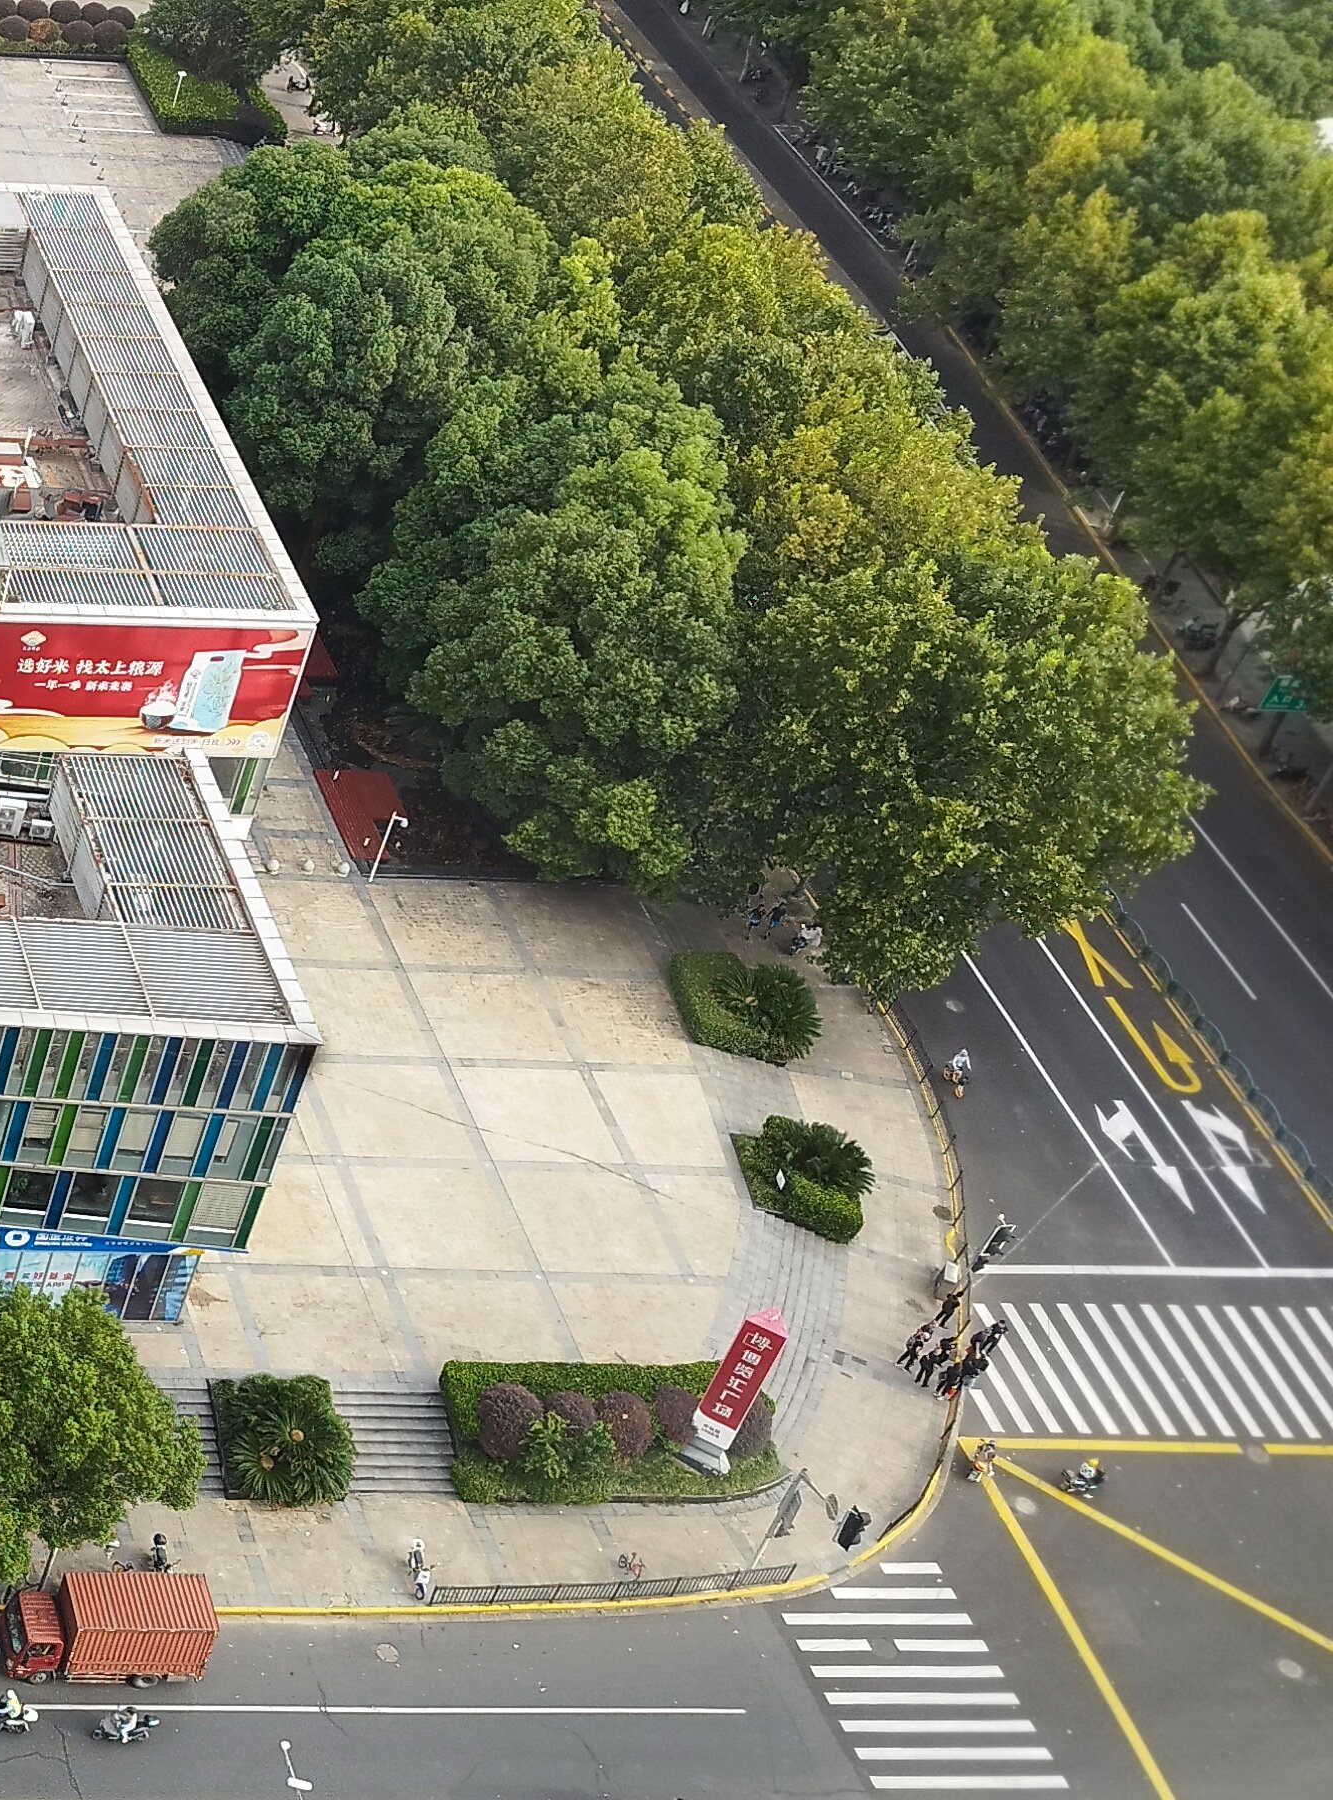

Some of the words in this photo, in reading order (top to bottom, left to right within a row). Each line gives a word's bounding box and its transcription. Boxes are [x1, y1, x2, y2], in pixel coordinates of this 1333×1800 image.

[17, 657, 70, 675] 选好米
[76, 660, 164, 676] 找太上粮源
